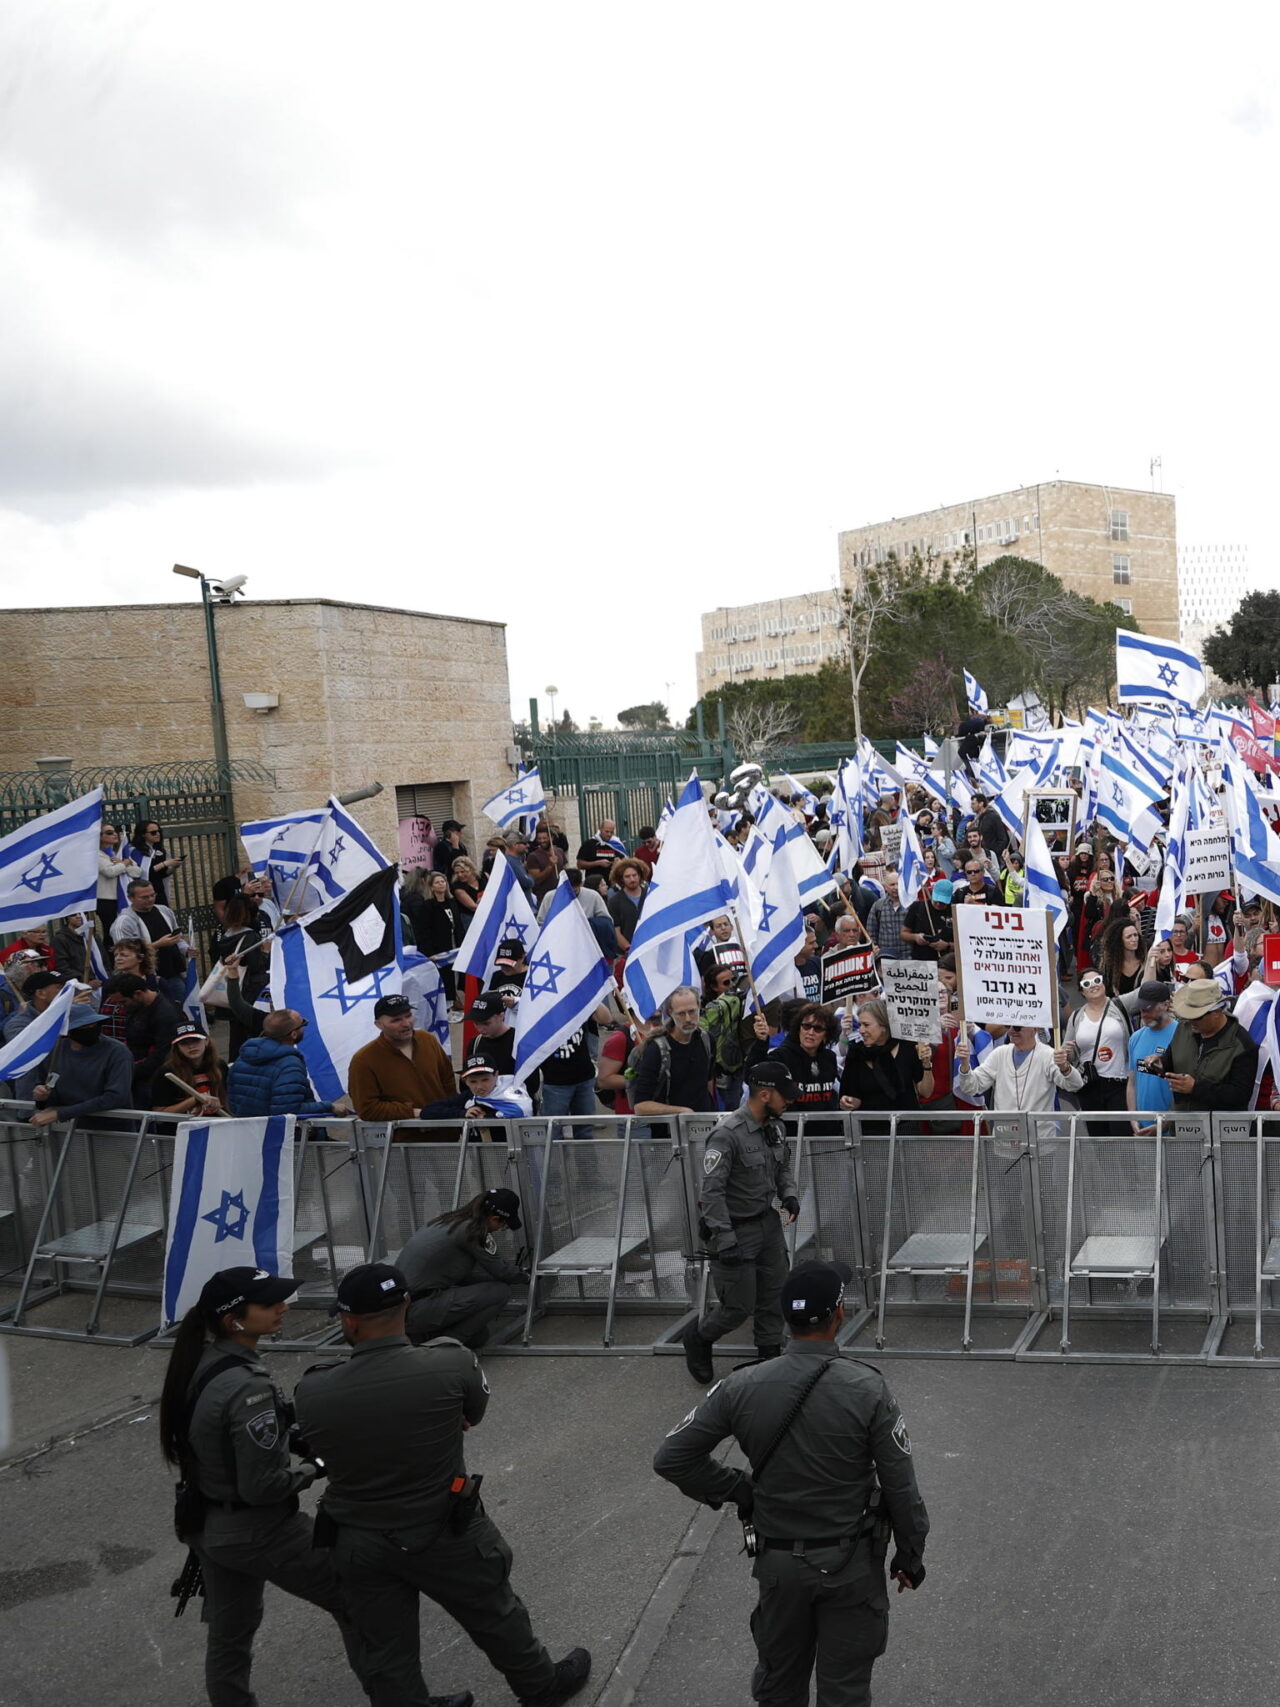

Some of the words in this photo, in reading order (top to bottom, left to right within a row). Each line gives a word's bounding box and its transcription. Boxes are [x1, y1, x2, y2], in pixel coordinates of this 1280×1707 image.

[984, 911, 1025, 931] ביבי
[973, 947, 984, 959] לי
[985, 949, 1014, 961] מעלה
[1015, 952, 1041, 962] ואתה
[974, 962, 1005, 973] נוראים
[1007, 963, 1042, 975] זכרונות
[886, 967, 934, 981] ديمقراطية
[893, 981, 929, 994] للجميع
[982, 980, 1015, 994] נדבר
[1018, 982, 1038, 996] בא
[887, 994, 938, 1007] דמוקרטיה
[976, 995, 995, 1006] אסון
[995, 997, 1025, 1008] שיקרה
[1025, 999, 1043, 1009] לפני
[1178, 1126, 1201, 1134] קשת
[215, 1295, 246, 1314] POLICE
